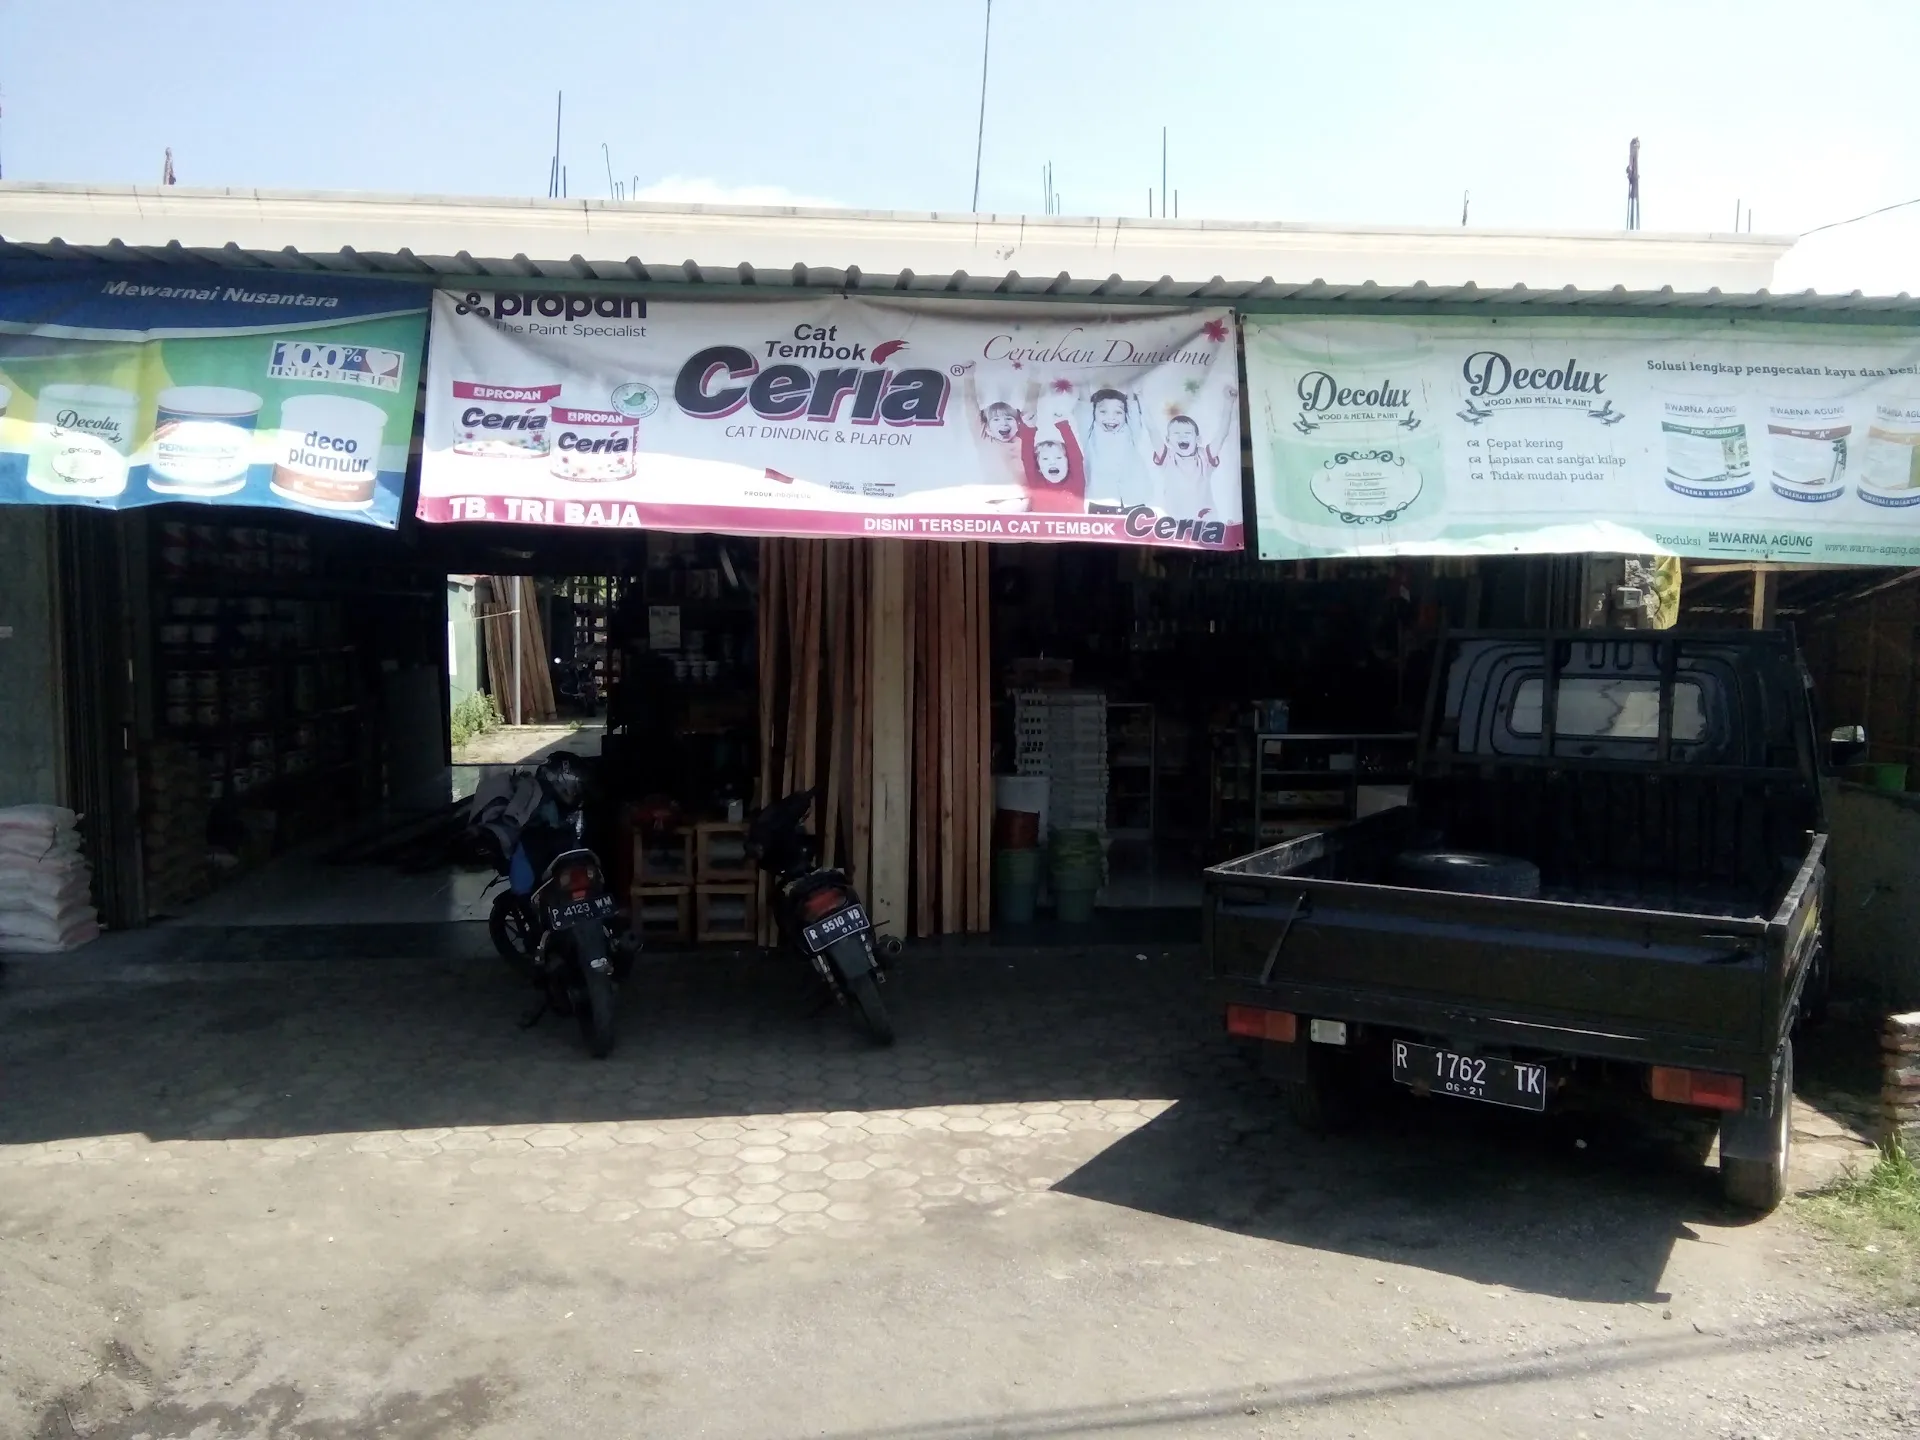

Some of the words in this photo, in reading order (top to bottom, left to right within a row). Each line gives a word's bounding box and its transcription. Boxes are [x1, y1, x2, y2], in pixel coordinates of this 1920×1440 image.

[101, 281, 220, 301] Mewarnai
[222, 287, 339, 308] Nusantara
[494, 293, 647, 321] propan
[496, 321, 524, 334] The
[529, 323, 568, 336] Paint
[573, 324, 647, 338] Specialist
[793, 323, 838, 343] Cat
[278, 341, 363, 371] 100%
[764, 340, 866, 362] Tembok
[983, 327, 1095, 364] Ceriakan
[1103, 338, 1212, 367] Duniamu
[1463, 351, 1609, 396] Decolux
[1647, 360, 1687, 371] Solusi
[1690, 362, 1743, 375] lengkap
[1746, 366, 1821, 377] pengecatan
[1825, 367, 1857, 379] kayu
[1860, 368, 1886, 377] dan
[486, 389, 541, 401] PROPAN
[674, 344, 951, 428] Ceria
[1298, 371, 1411, 412] Decolux
[1483, 398, 1512, 407] WOOD
[1534, 397, 1562, 405] METAL
[1565, 399, 1592, 407] PAINT
[1669, 405, 1704, 414] WARNA
[1777, 407, 1811, 416] WARNA
[56, 409, 121, 432] Decolux
[461, 407, 548, 431] Ceria
[577, 412, 623, 424] PROPAN
[1351, 412, 1375, 420] METAL
[305, 431, 358, 454] deco
[558, 431, 630, 454] Ceria
[725, 425, 758, 438] CAT
[760, 426, 829, 443] DINDING
[834, 430, 846, 443] &
[850, 431, 912, 446] PLAFON
[1486, 438, 1521, 450] Cepat
[1525, 438, 1564, 450] kering
[288, 448, 369, 473] plamuur
[1488, 454, 1534, 467] Lapisan
[1556, 456, 1595, 465] sangat
[1597, 454, 1627, 466] kilap
[1490, 471, 1525, 481] Tidak
[1527, 471, 1568, 481] mudah
[1570, 471, 1605, 483] pudar
[449, 497, 495, 520] TB.
[504, 499, 554, 522] TRI
[565, 502, 641, 527] BAJA
[864, 518, 914, 531] DISINI
[918, 519, 1003, 533] TERSEDIA
[1007, 520, 1041, 533] CAT
[1045, 522, 1116, 536] TEMBOK
[1123, 506, 1226, 545] Ceria
[1656, 533, 1701, 545] Produksi
[1721, 533, 1768, 545] WARNA
[1771, 534, 1813, 547] AGUNG
[564, 902, 590, 916] 4123
[595, 896, 613, 908] WM
[809, 929, 818, 940] R
[822, 915, 845, 933] 5510
[847, 908, 860, 920] VB
[1396, 1043, 1408, 1069] R
[1435, 1051, 1486, 1085] 1762
[1513, 1065, 1541, 1094] TK
